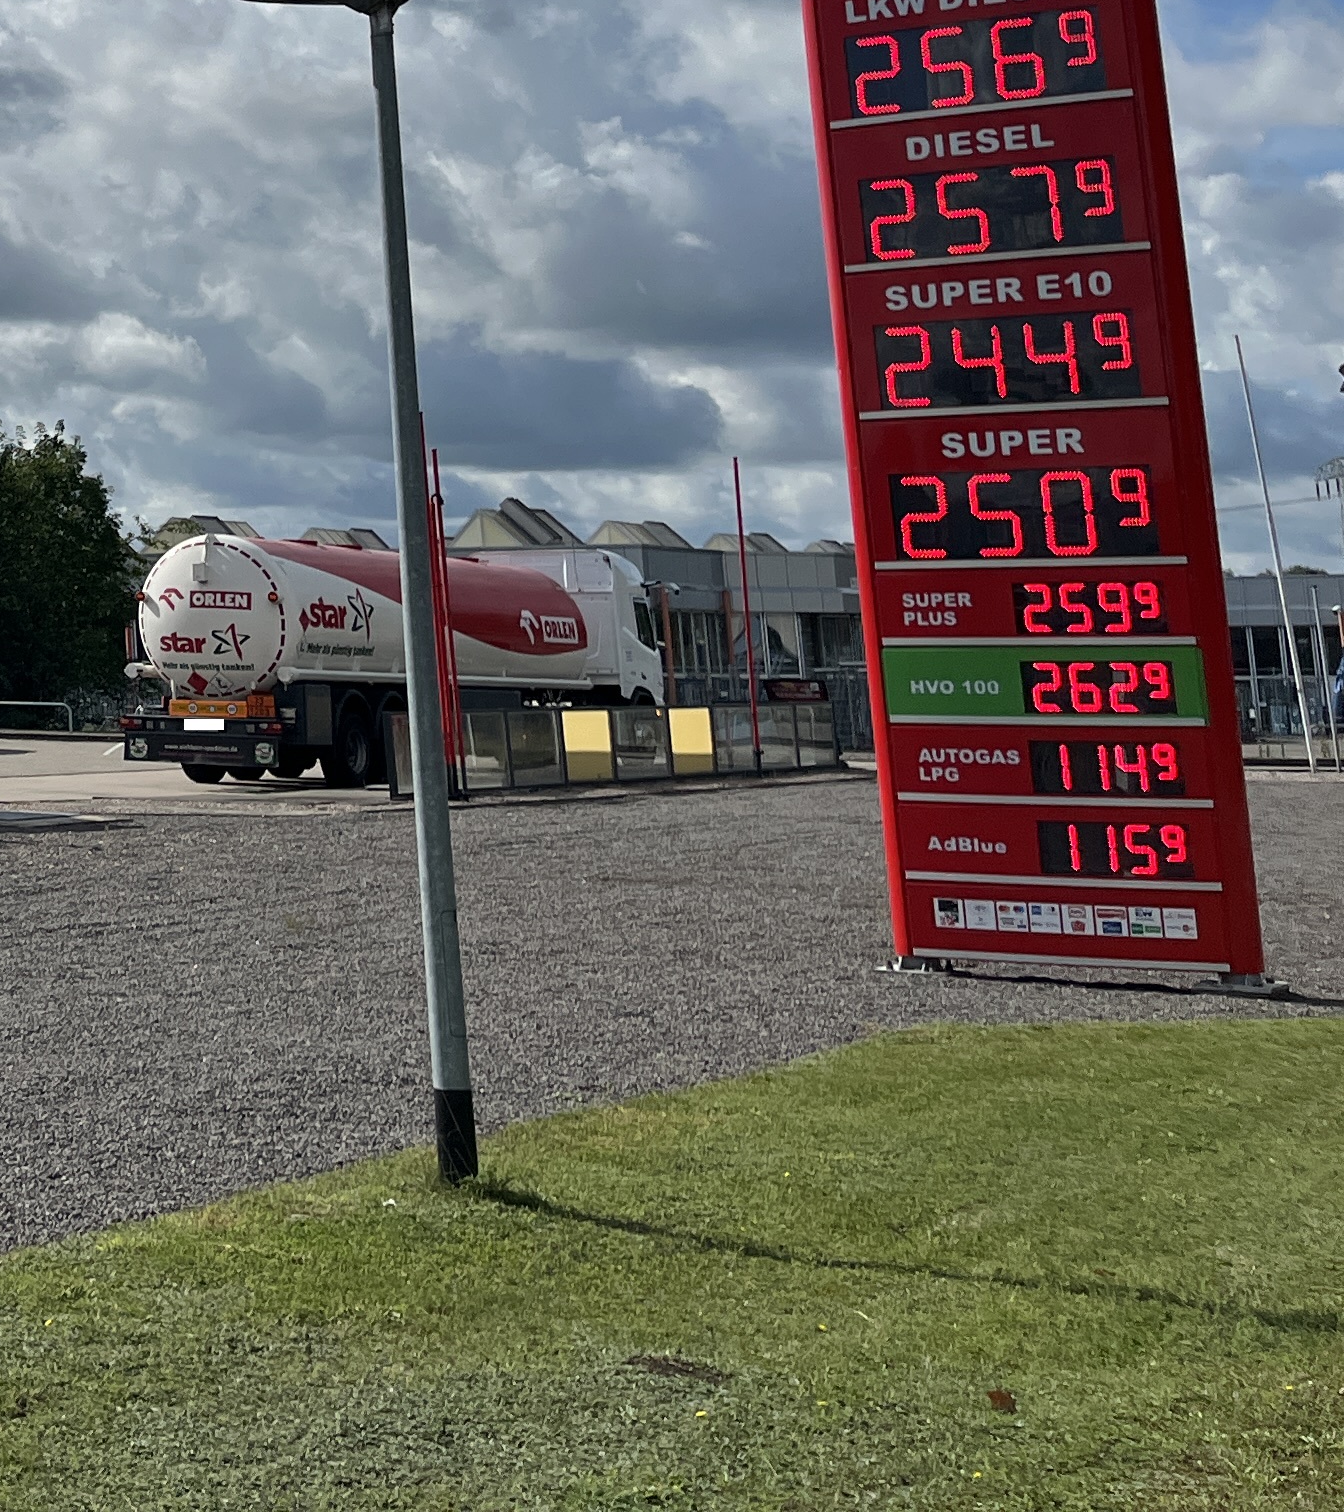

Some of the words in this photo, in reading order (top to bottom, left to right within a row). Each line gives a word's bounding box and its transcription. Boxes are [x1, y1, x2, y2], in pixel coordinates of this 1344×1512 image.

[905, 124, 1055, 161] DIESEL
[885, 277, 1024, 311] SUPER
[1037, 271, 1112, 300] E10
[941, 428, 1085, 459] SUPER
[192, 593, 248, 608] ORLEN
[902, 592, 973, 609] SUPER
[310, 596, 347, 630] star
[903, 611, 957, 627] PLUS
[544, 620, 577, 639] ORLEN
[160, 632, 206, 654] star
[909, 679, 956, 696] HVO
[961, 679, 1000, 696] 100
[919, 748, 1020, 765] AUTOGAS
[919, 767, 960, 783] LPG
[928, 836, 1007, 854] AdBlue
